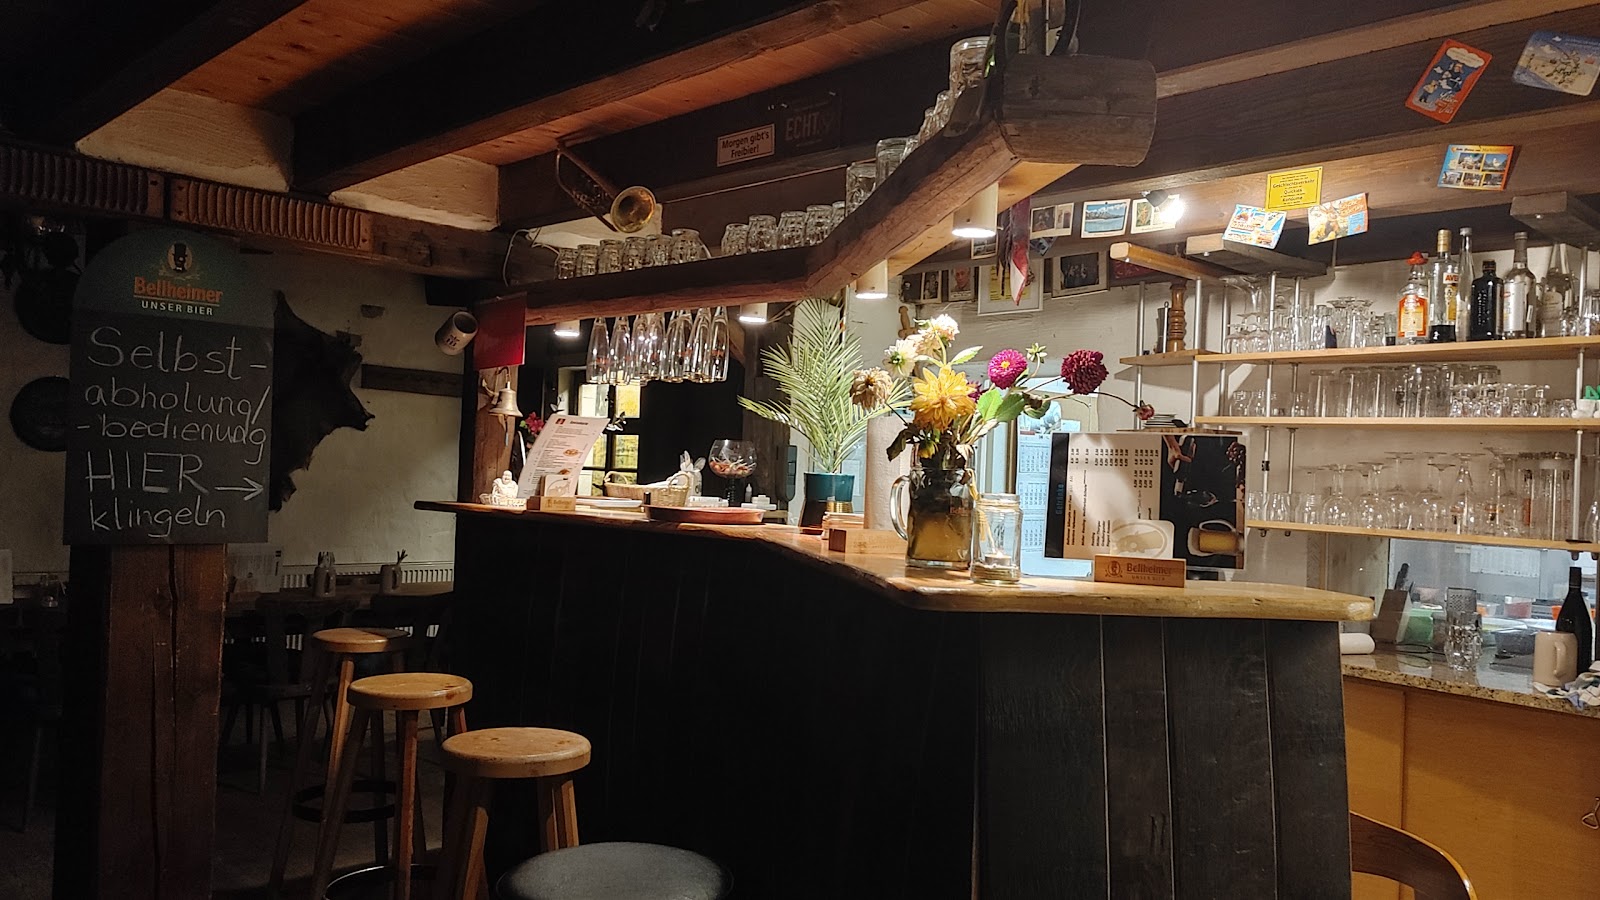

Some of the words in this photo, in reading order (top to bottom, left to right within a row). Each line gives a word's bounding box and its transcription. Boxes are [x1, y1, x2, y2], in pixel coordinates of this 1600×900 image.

[721, 137, 748, 149] Morgen
[750, 131, 769, 144] gibt's
[730, 144, 759, 158] Freibier!
[133, 276, 223, 303] Bellheimer
[141, 300, 182, 312] UNSER
[187, 305, 213, 316] BIER
[88, 326, 267, 380] Selbst-
[85, 377, 271, 432] abholung/
[85, 449, 210, 495] HIER
[89, 495, 226, 537] klingeln
[1126, 562, 1172, 575] Bellheimer
